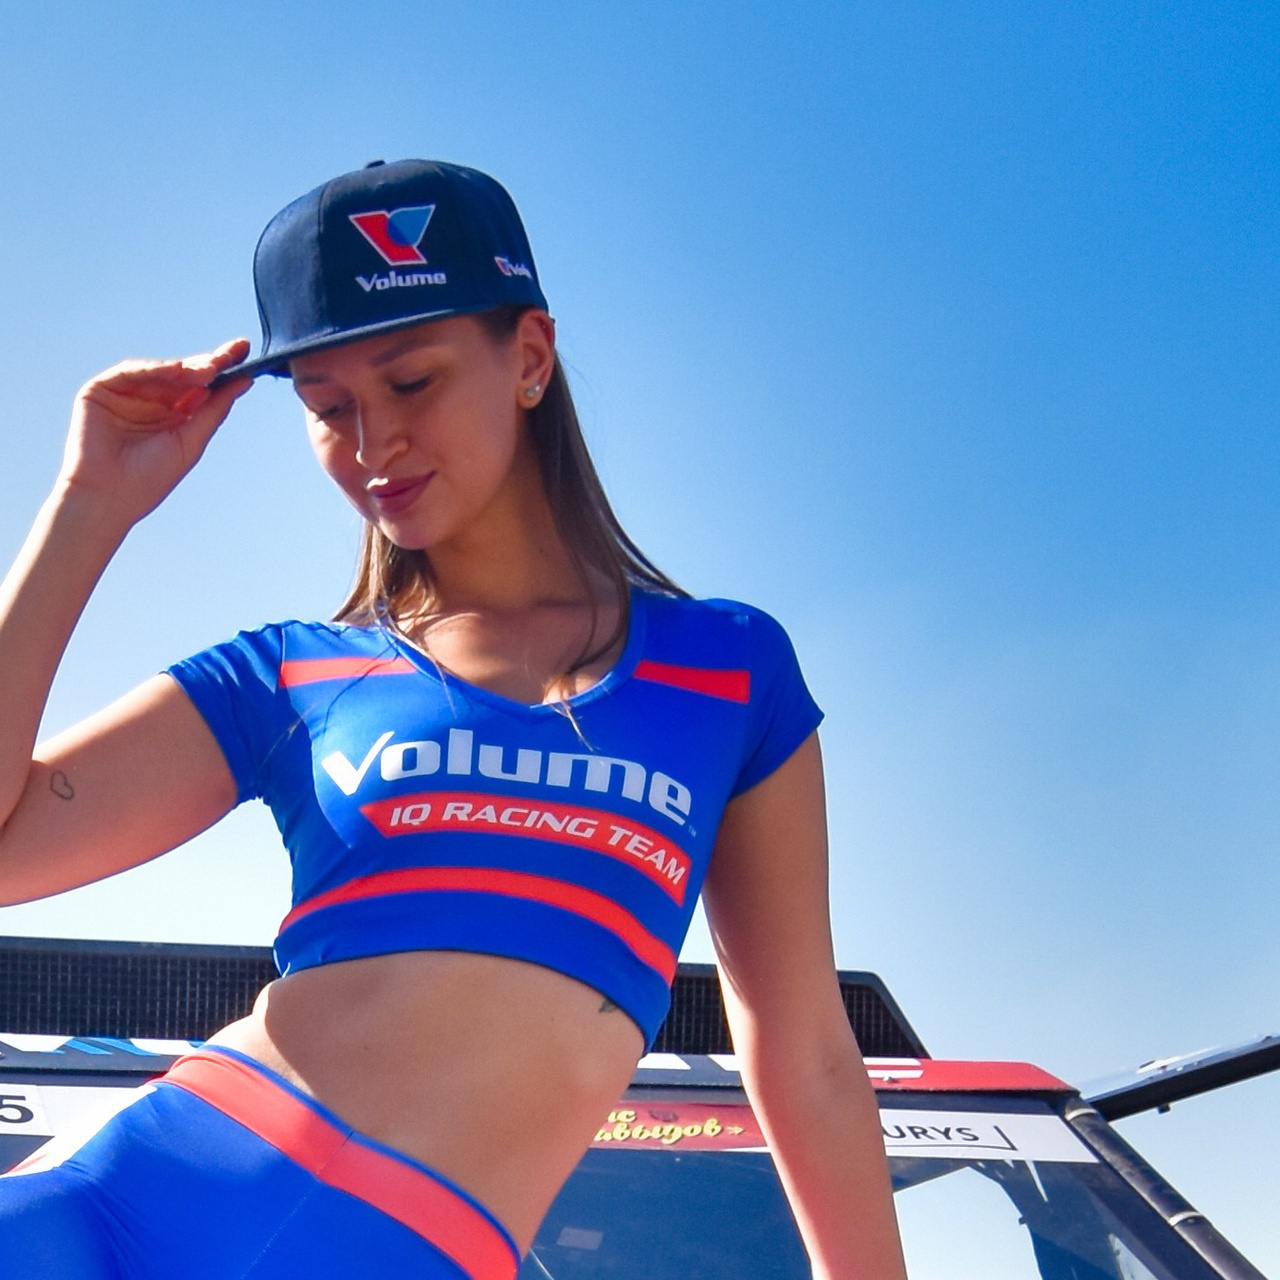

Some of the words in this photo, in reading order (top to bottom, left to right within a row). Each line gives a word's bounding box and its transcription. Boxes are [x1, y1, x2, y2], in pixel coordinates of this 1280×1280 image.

[355, 270, 447, 293] Volume
[321, 728, 692, 826] Volume
[390, 802, 432, 828] IQ
[442, 801, 599, 839] RACING
[609, 825, 687, 886] TEAM
